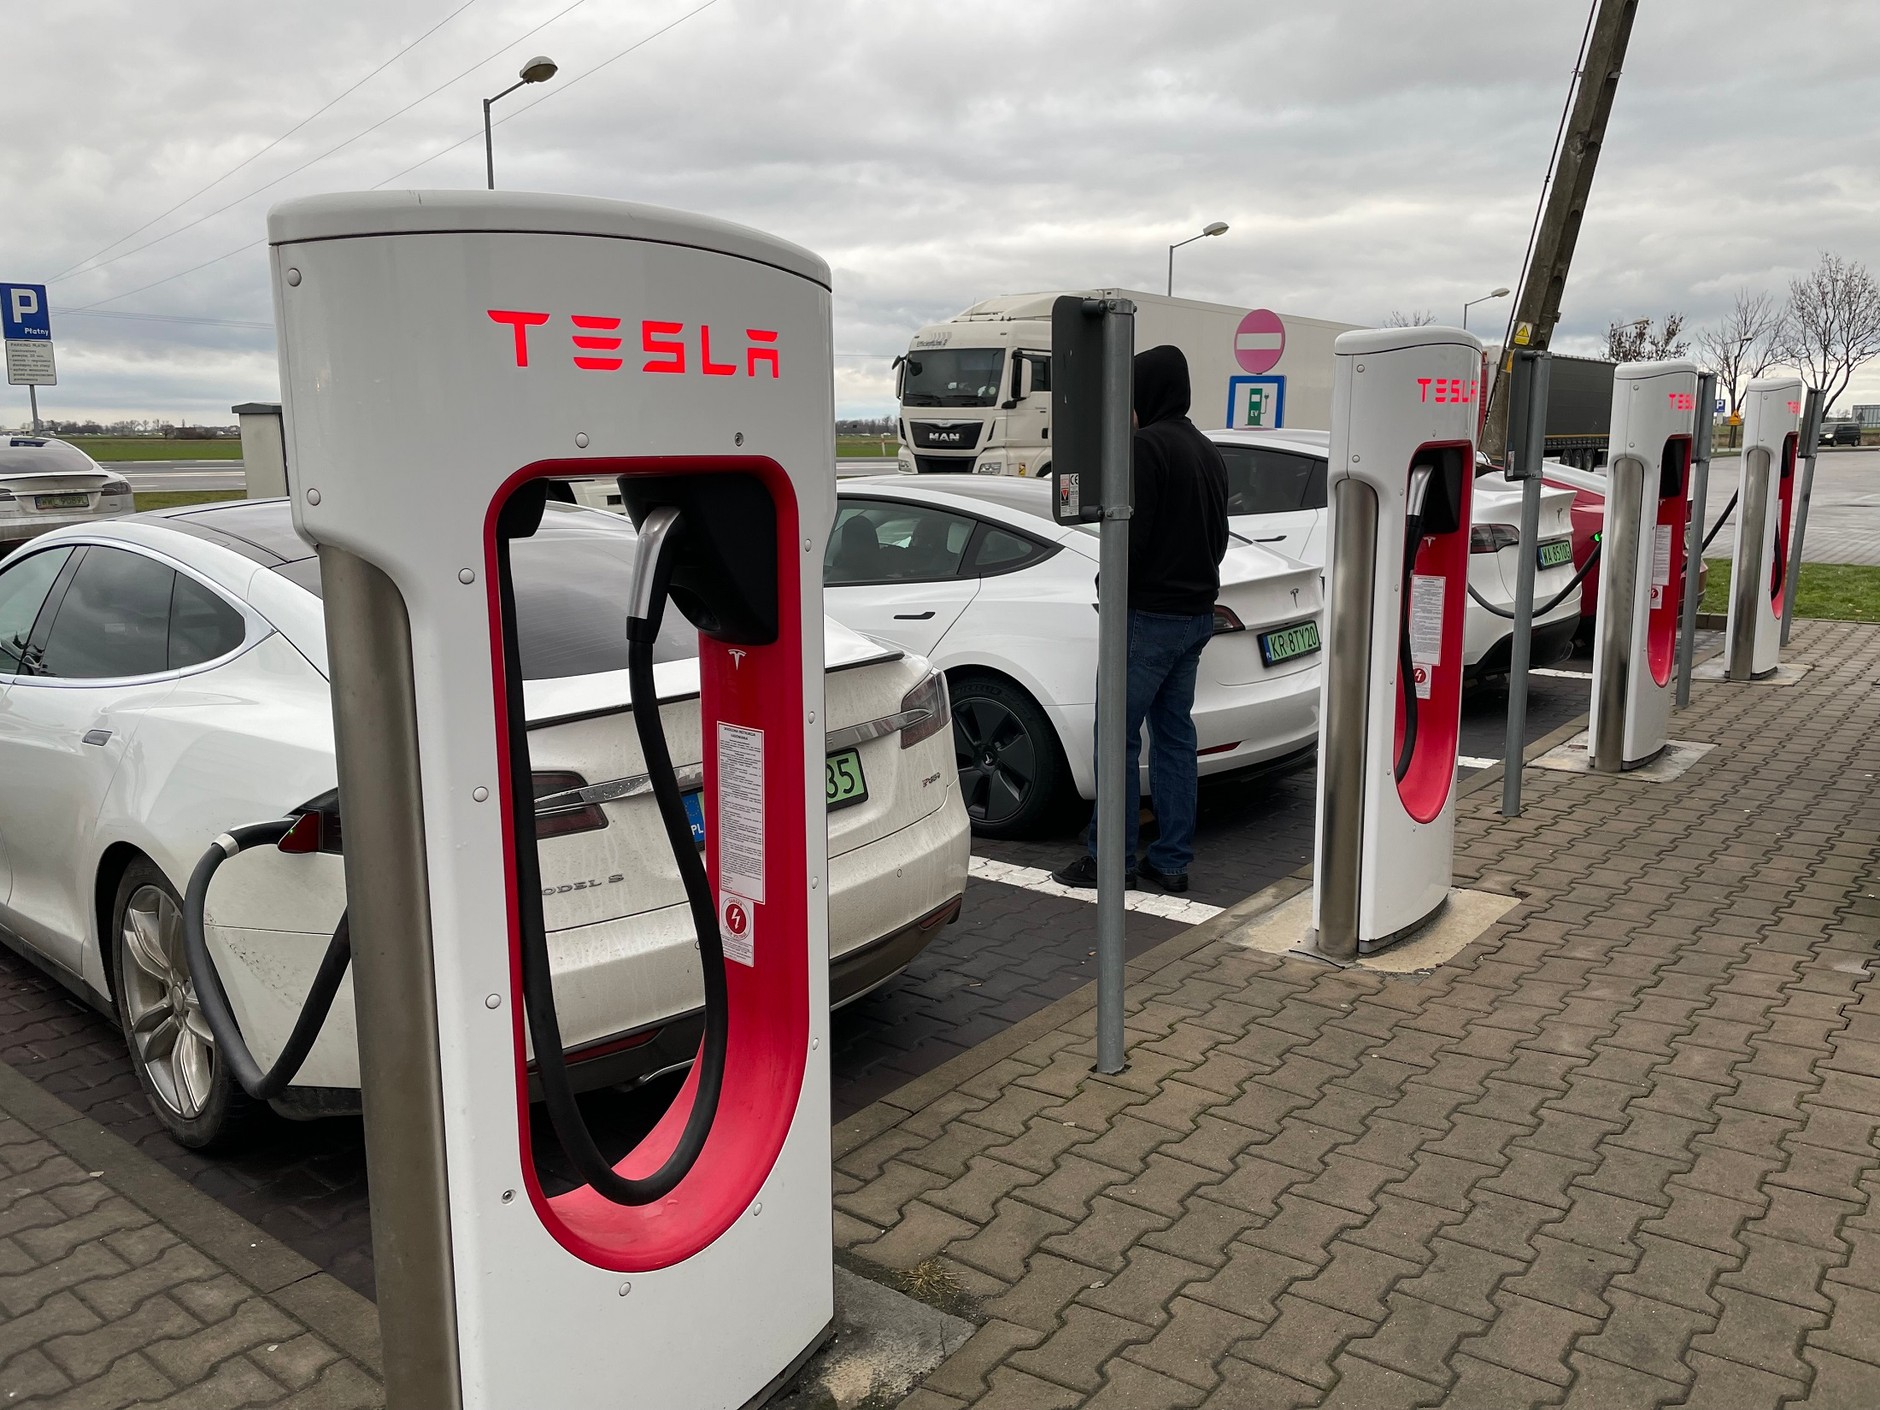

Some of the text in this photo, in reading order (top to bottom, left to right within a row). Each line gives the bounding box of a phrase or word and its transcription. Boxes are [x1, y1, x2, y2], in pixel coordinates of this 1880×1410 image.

[11, 289, 38, 323] P
[24, 327, 49, 337] Płatny
[487, 310, 779, 379] TESLA
[1716, 400, 1724, 410] P
[929, 432, 960, 442] MAN
[1270, 634, 1288, 658] KR
[1288, 626, 1317, 652] 8TY20
[690, 823, 704, 836] PL
[541, 873, 625, 896] ODEL S
